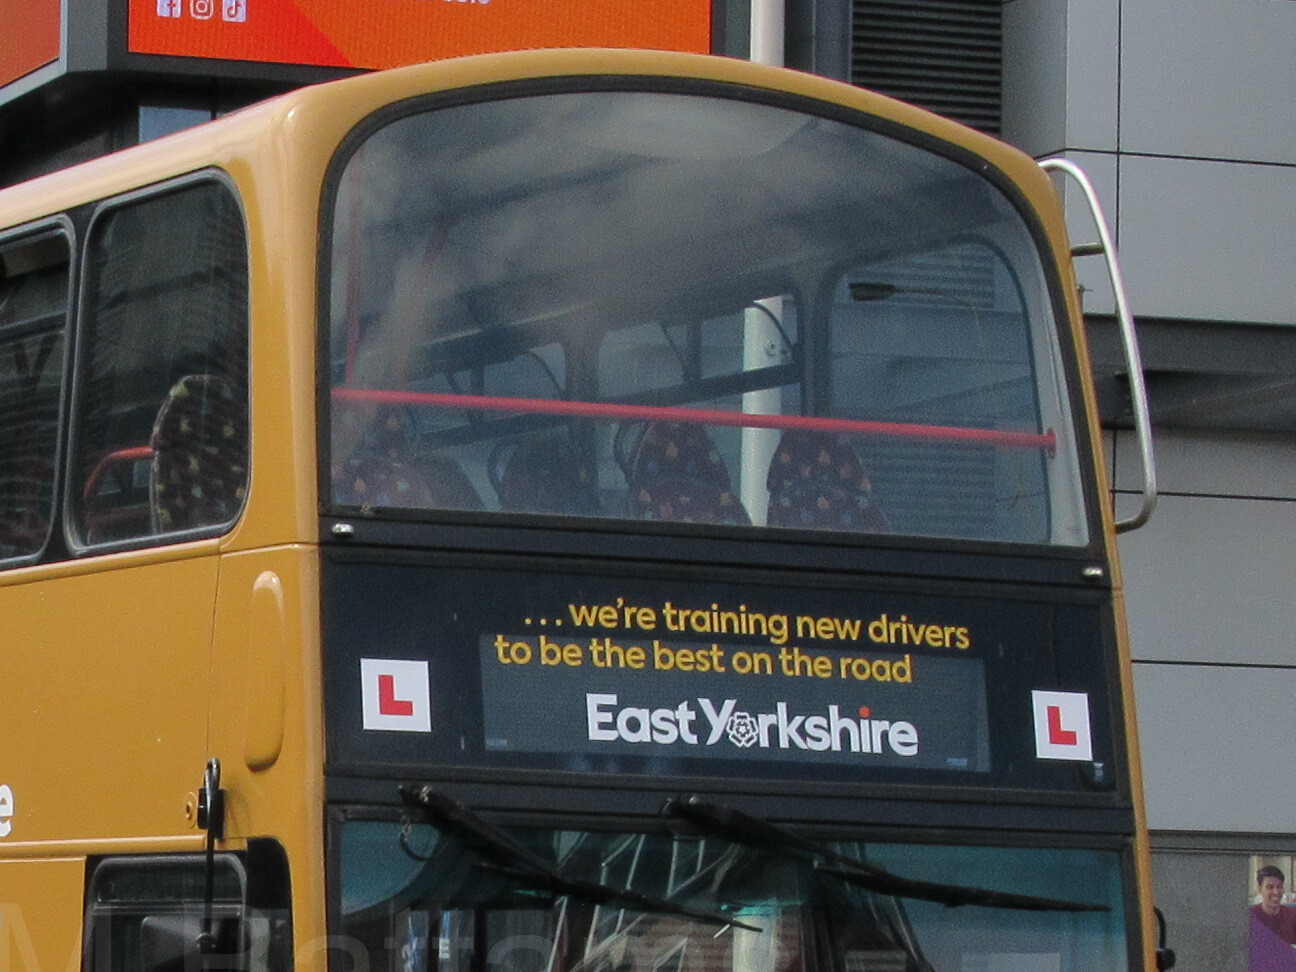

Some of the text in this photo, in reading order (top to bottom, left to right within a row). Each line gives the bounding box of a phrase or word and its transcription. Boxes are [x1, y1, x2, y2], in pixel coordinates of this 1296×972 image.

[662, 602, 789, 642] training
[796, 615, 862, 640] new
[868, 614, 970, 649] drivers
[494, 635, 913, 683] to be the best on the road
[379, 674, 414, 716] L
[585, 692, 698, 745] East
[1046, 705, 1078, 745] L
